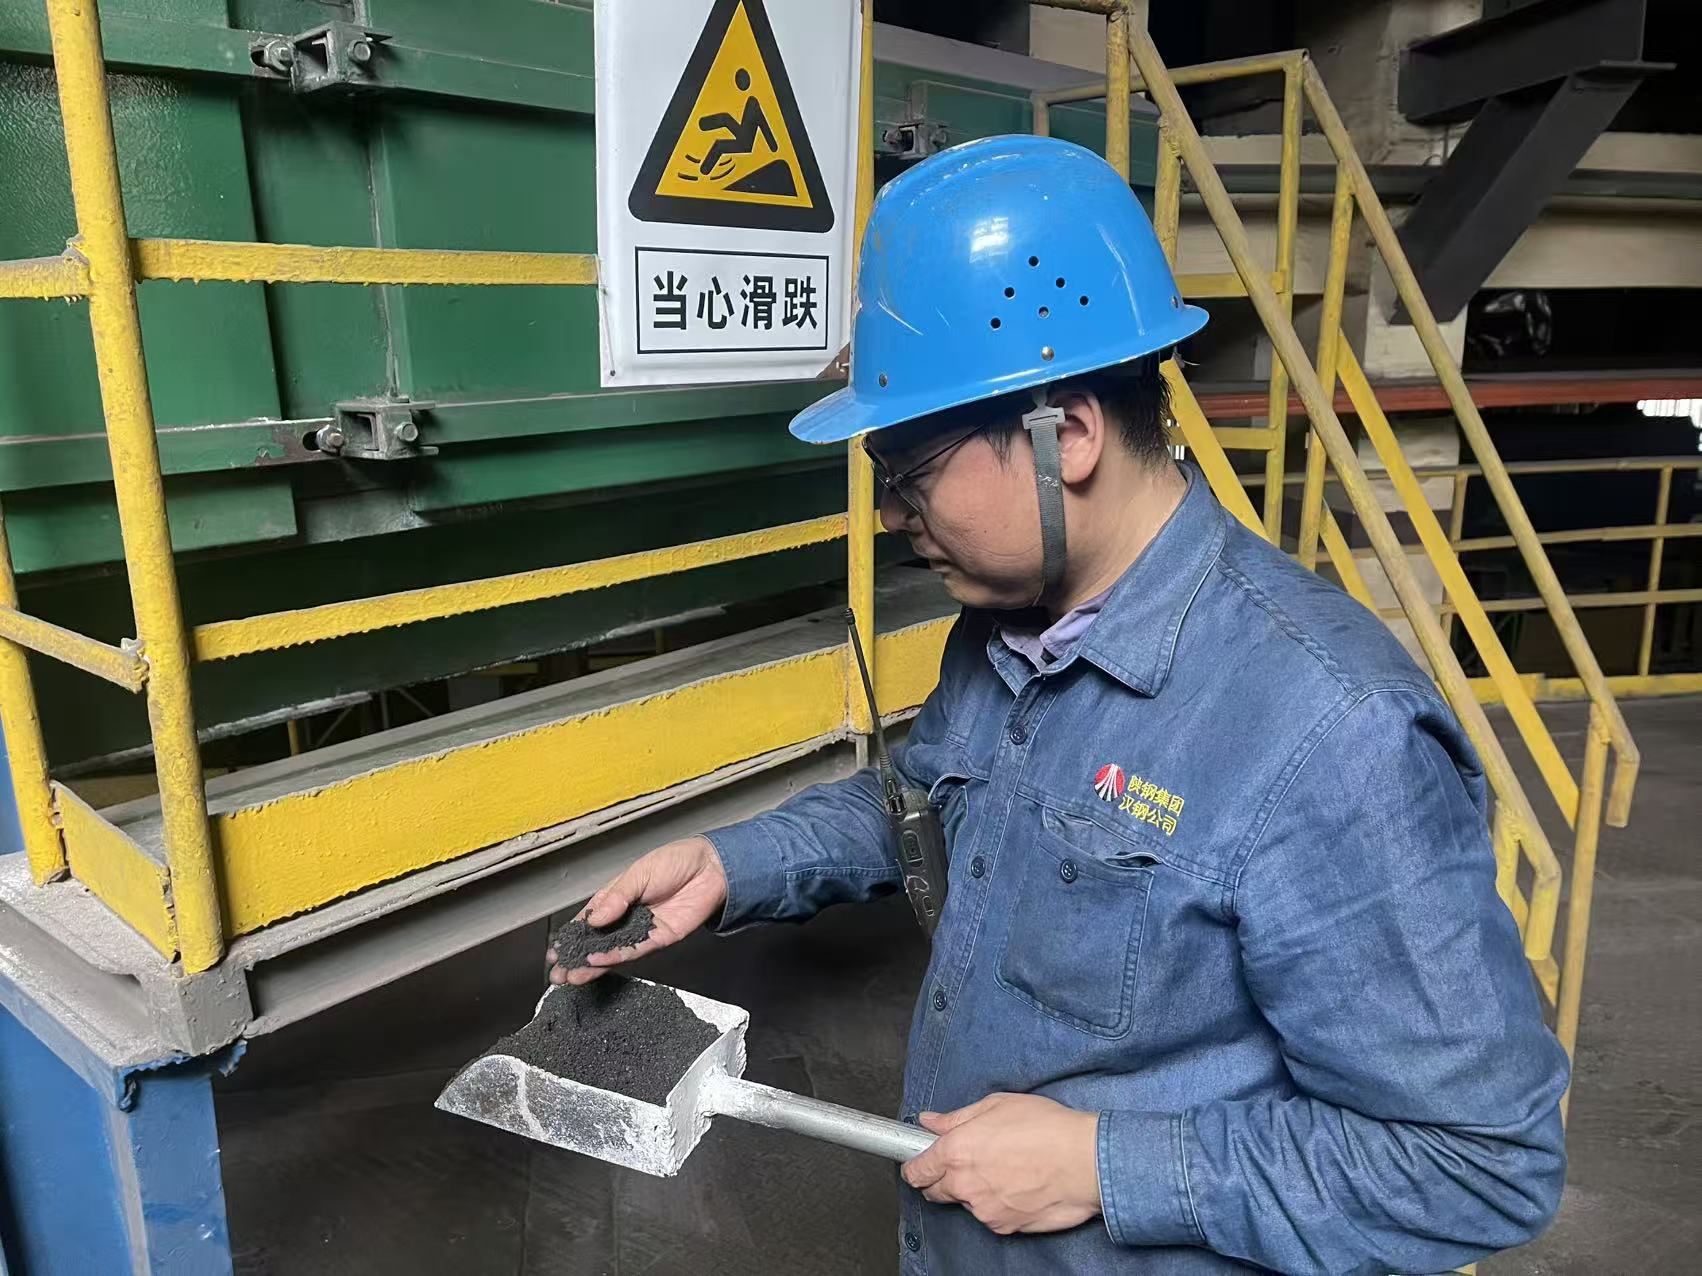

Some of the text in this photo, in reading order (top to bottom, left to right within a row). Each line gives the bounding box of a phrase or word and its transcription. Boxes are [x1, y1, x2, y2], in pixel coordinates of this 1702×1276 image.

[653, 271, 818, 329] 当心滑跌
[1119, 793, 1177, 836] 汉钢公司
[1128, 775, 1184, 817] 陕钢集团
